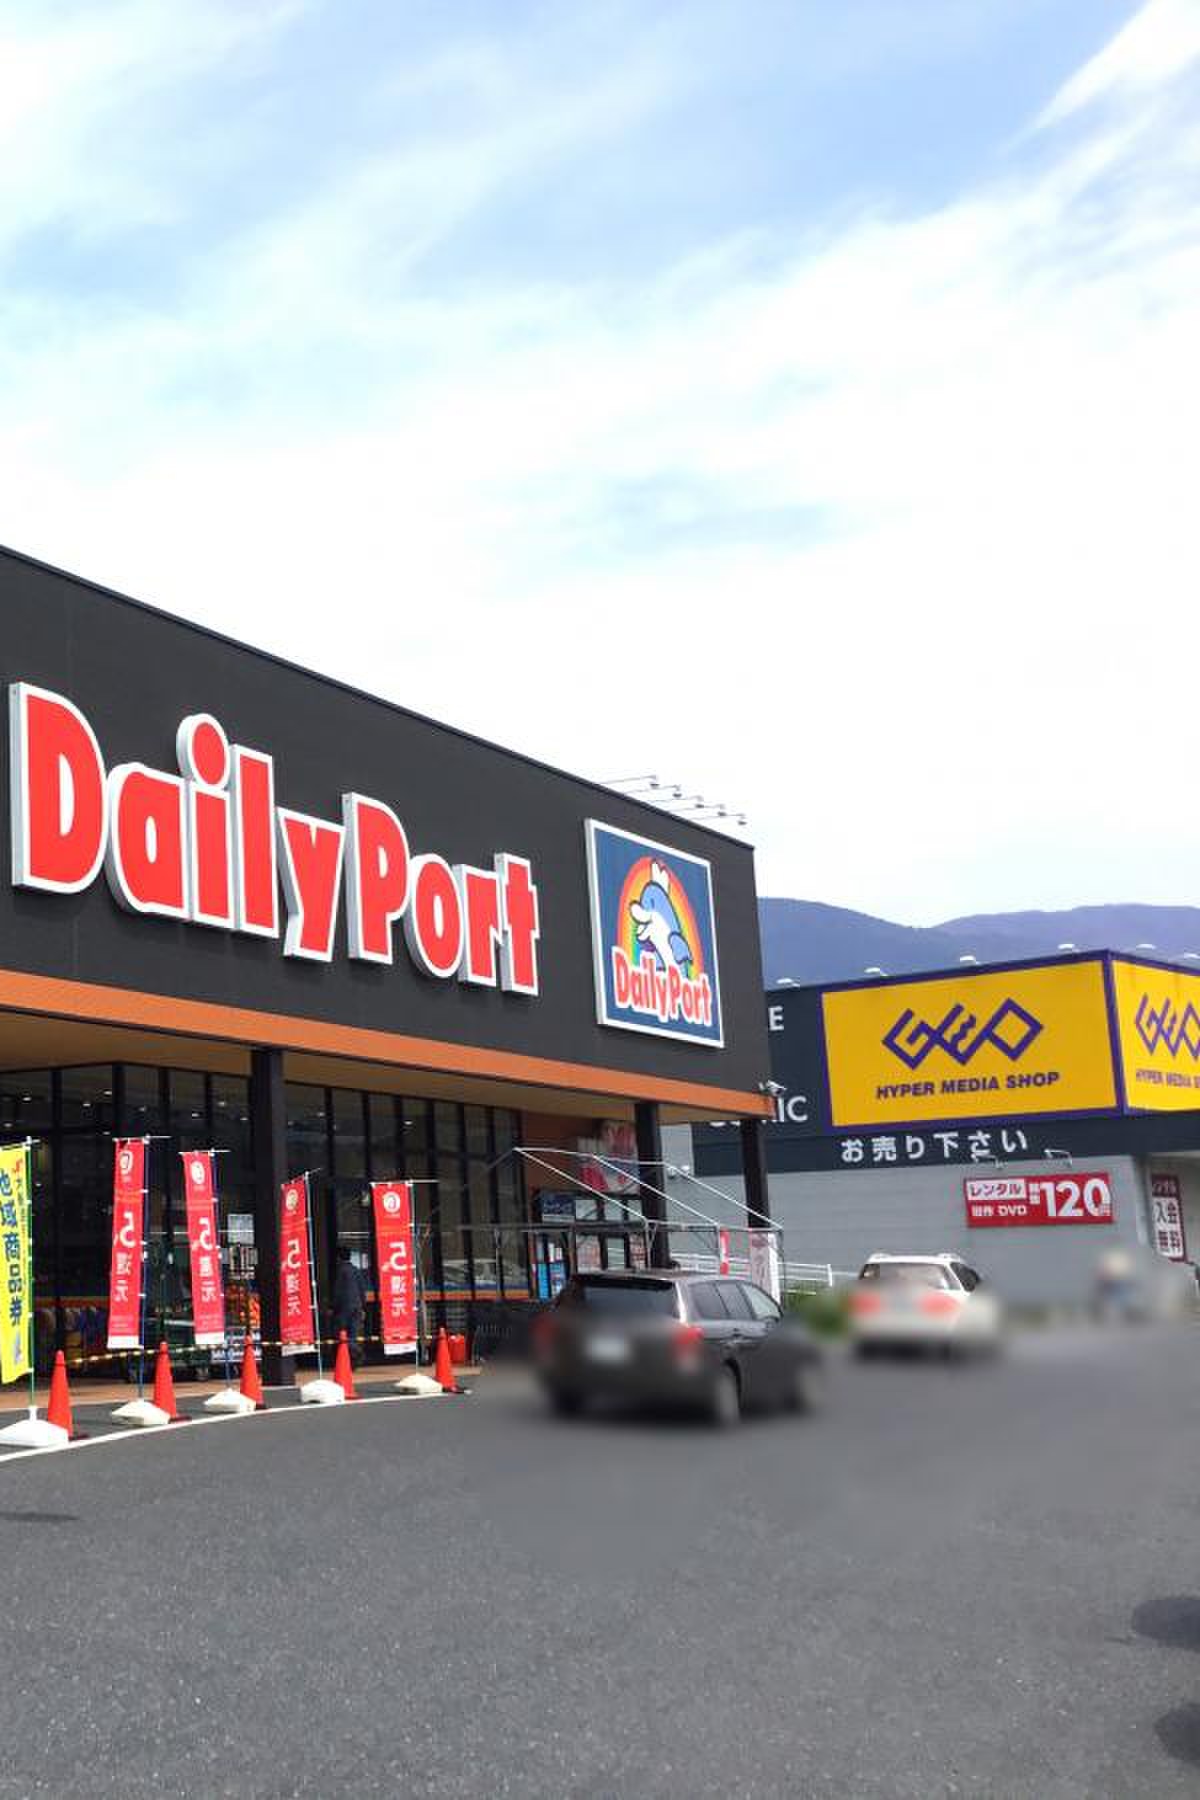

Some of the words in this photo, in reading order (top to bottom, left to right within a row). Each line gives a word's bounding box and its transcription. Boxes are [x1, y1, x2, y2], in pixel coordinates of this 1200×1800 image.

[876, 1082, 934, 1099] HYPER
[941, 1077, 999, 1094] MEDIA
[1006, 1072, 1060, 1089] SHOP
[841, 1130, 1028, 1162] お売り下さい
[998, 1204, 1027, 1216] DVD
